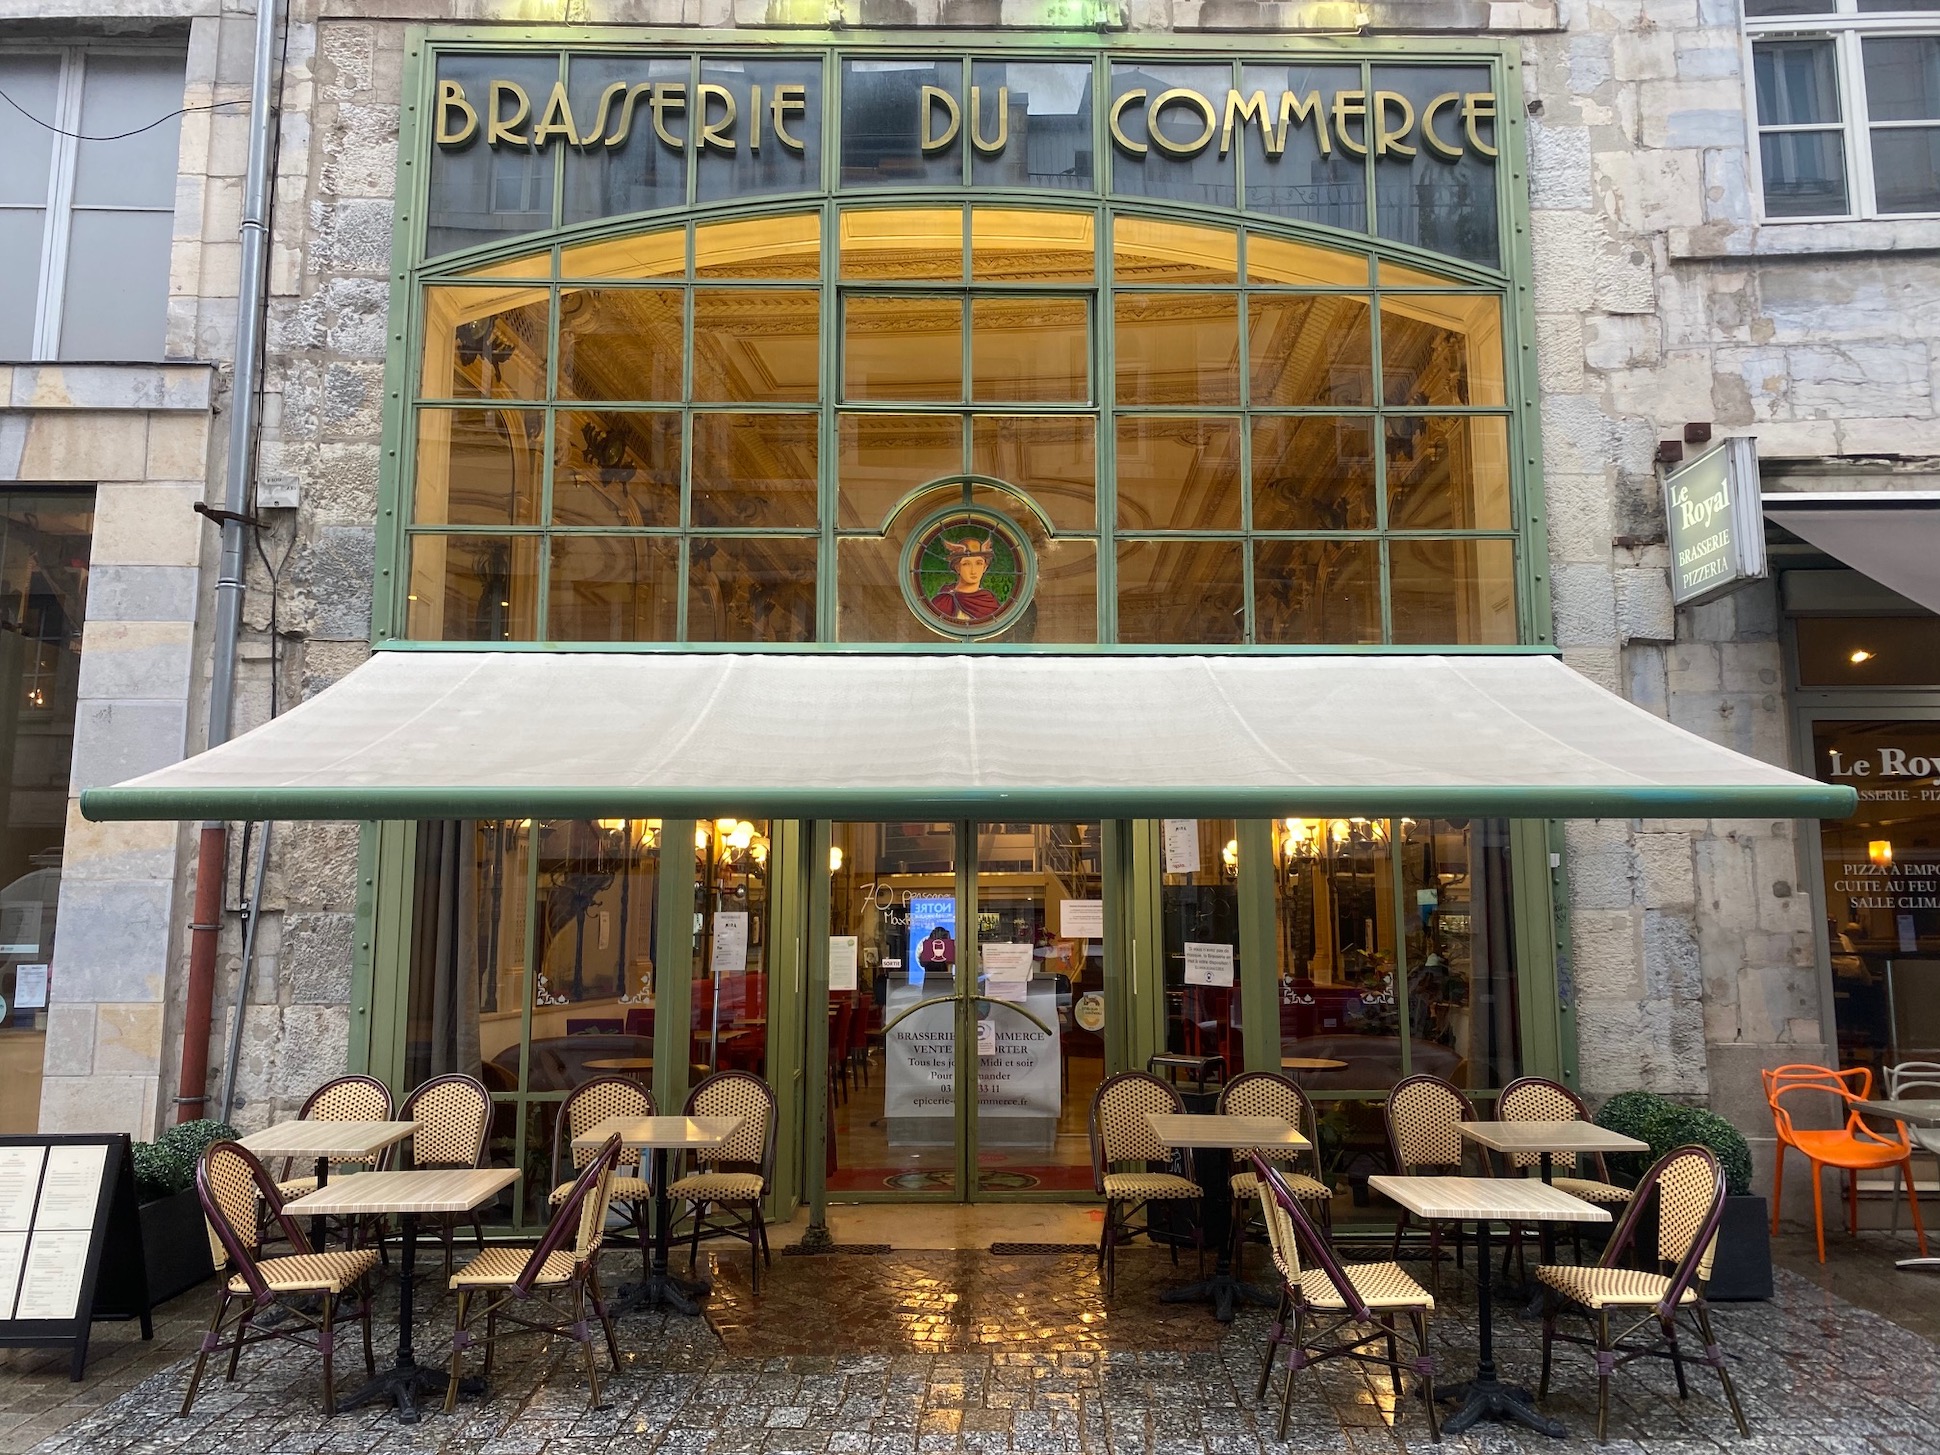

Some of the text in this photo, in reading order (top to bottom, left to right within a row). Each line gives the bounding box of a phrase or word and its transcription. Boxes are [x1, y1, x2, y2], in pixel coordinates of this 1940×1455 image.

[436, 79, 1499, 161] BRASSERIE DU COMMERCE
[1670, 485, 1689, 508] Le
[1680, 478, 1731, 530] Royal
[1678, 529, 1731, 567] BRASSERIE
[1682, 556, 1729, 590] PIZZERIA
[1830, 752, 1871, 777] Le
[1844, 864, 1888, 876] PIZZA
[1891, 861, 1901, 876] À
[1834, 880, 1937, 892] CUITE AU FEU
[859, 882, 894, 914] 70
[1850, 896, 1896, 909] SALLE
[897, 1032, 1045, 1041] BRASSERIE MMERCE
[913, 1045, 953, 1054] VENTE
[908, 1057, 931, 1067] Tous
[933, 1057, 946, 1067] les
[980, 1058, 1002, 1067] Midi
[1005, 1059, 1014, 1067] et
[1016, 1058, 1034, 1067] soir
[931, 1071, 953, 1080] Pour
[940, 1084, 952, 1093] 03
[992, 1084, 1001, 1093] 11
